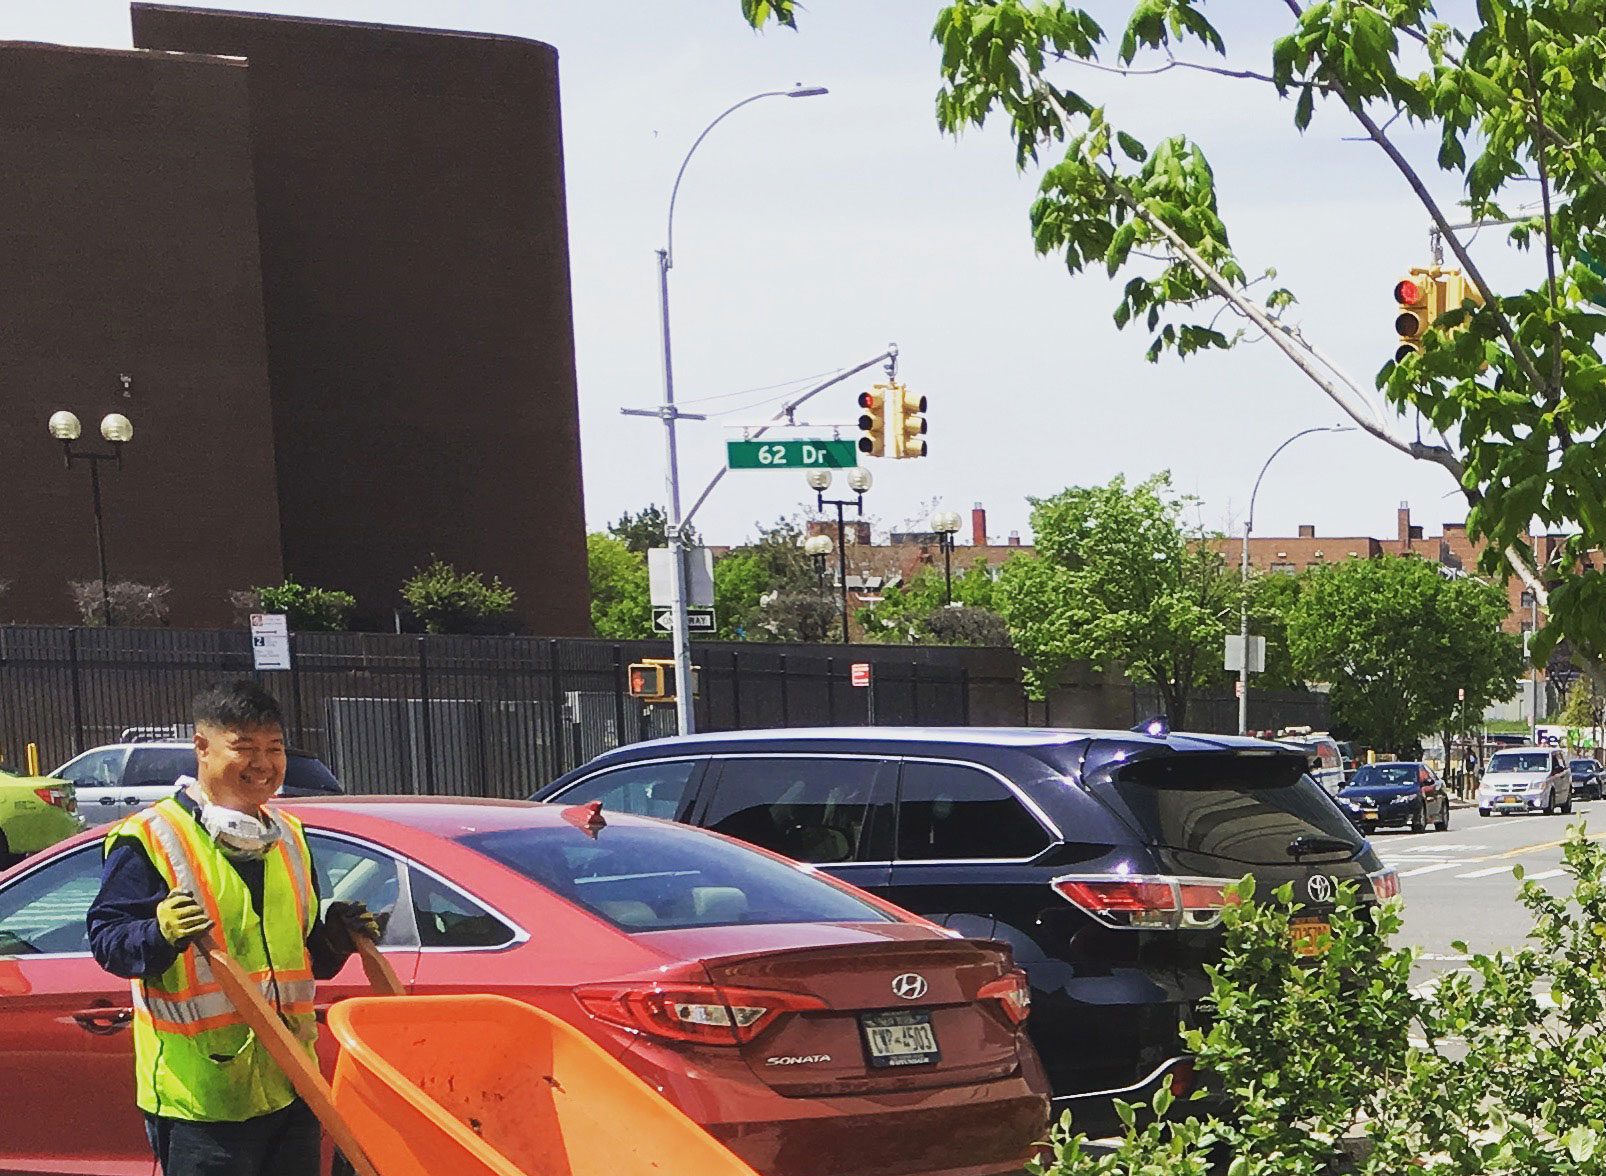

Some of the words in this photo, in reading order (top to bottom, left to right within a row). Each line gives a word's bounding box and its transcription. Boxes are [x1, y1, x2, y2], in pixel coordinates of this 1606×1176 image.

[758, 445, 787, 464] 62
[802, 445, 827, 464] Dr
[765, 1055, 831, 1066] SONATA
